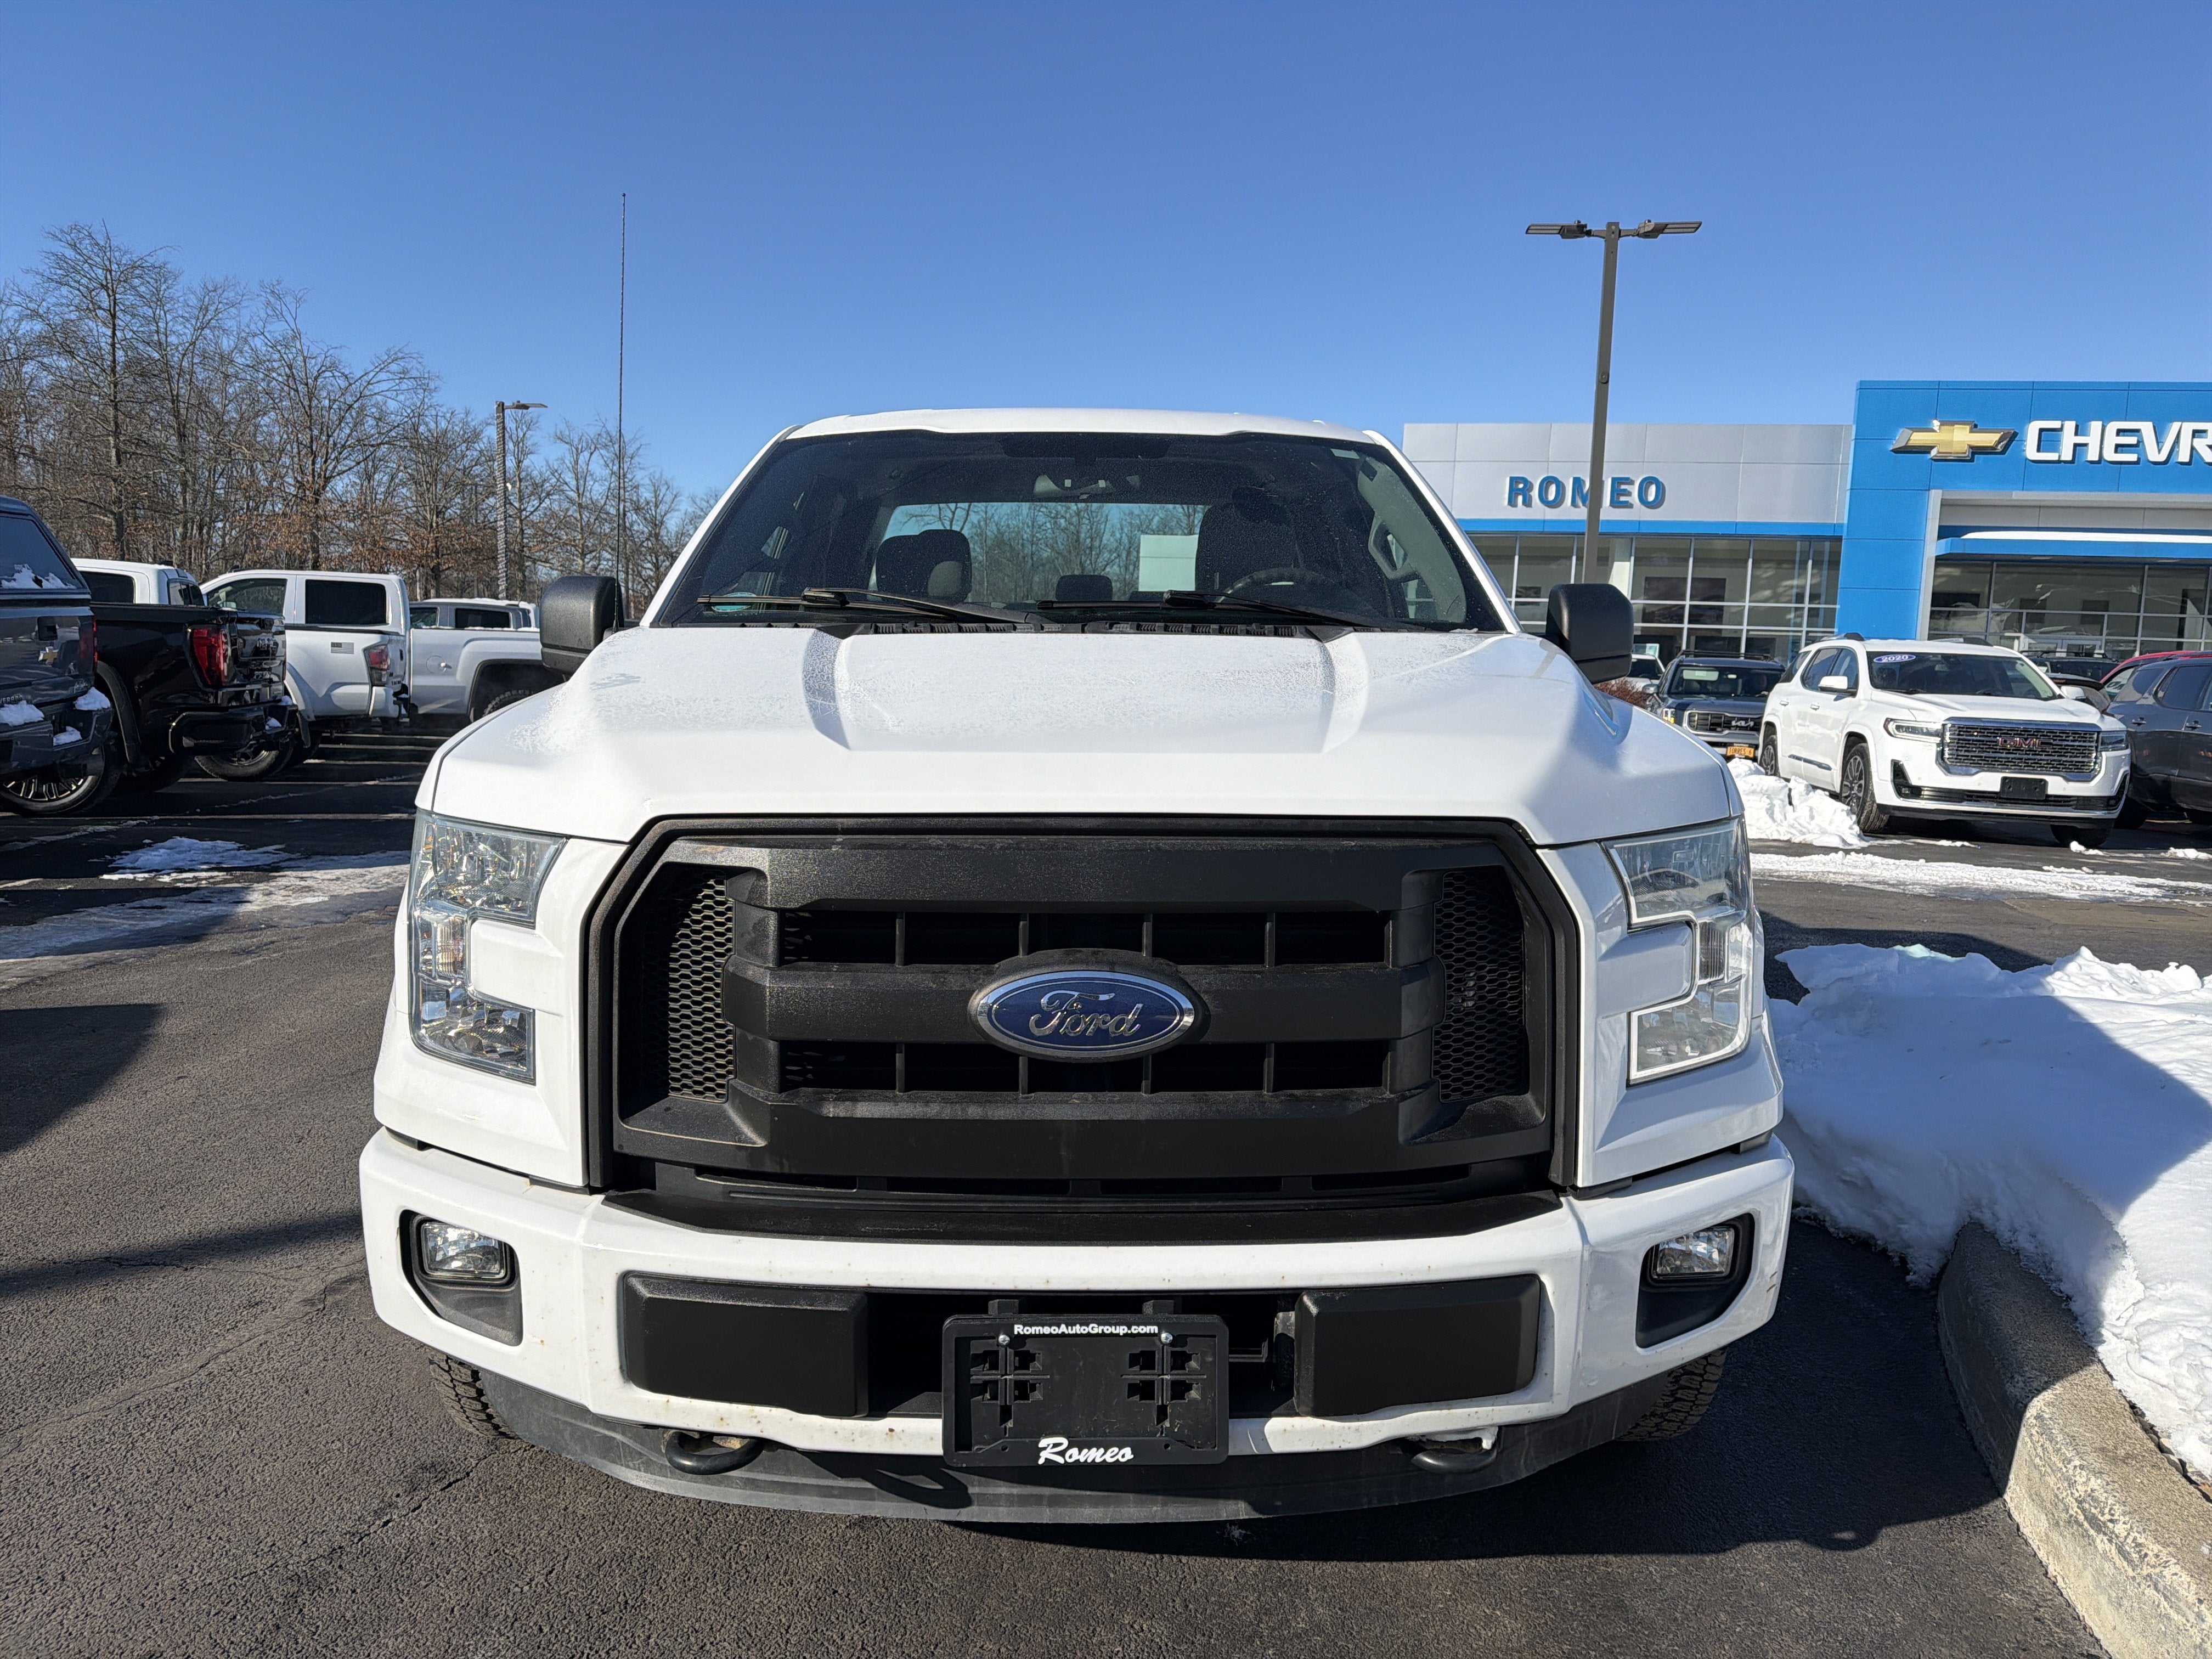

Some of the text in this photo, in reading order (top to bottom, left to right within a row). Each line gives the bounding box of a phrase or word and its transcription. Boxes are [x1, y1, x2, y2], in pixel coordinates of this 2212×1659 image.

[2026, 420, 2212, 463] CHEVR
[1507, 475, 1663, 507] ROMEO
[1997, 737, 2053, 749] GMC
[1029, 990, 1144, 1037] Ford
[1014, 1324, 1158, 1335] RomeoAutoGroup.com
[1038, 1437, 1134, 1465] Romeo
